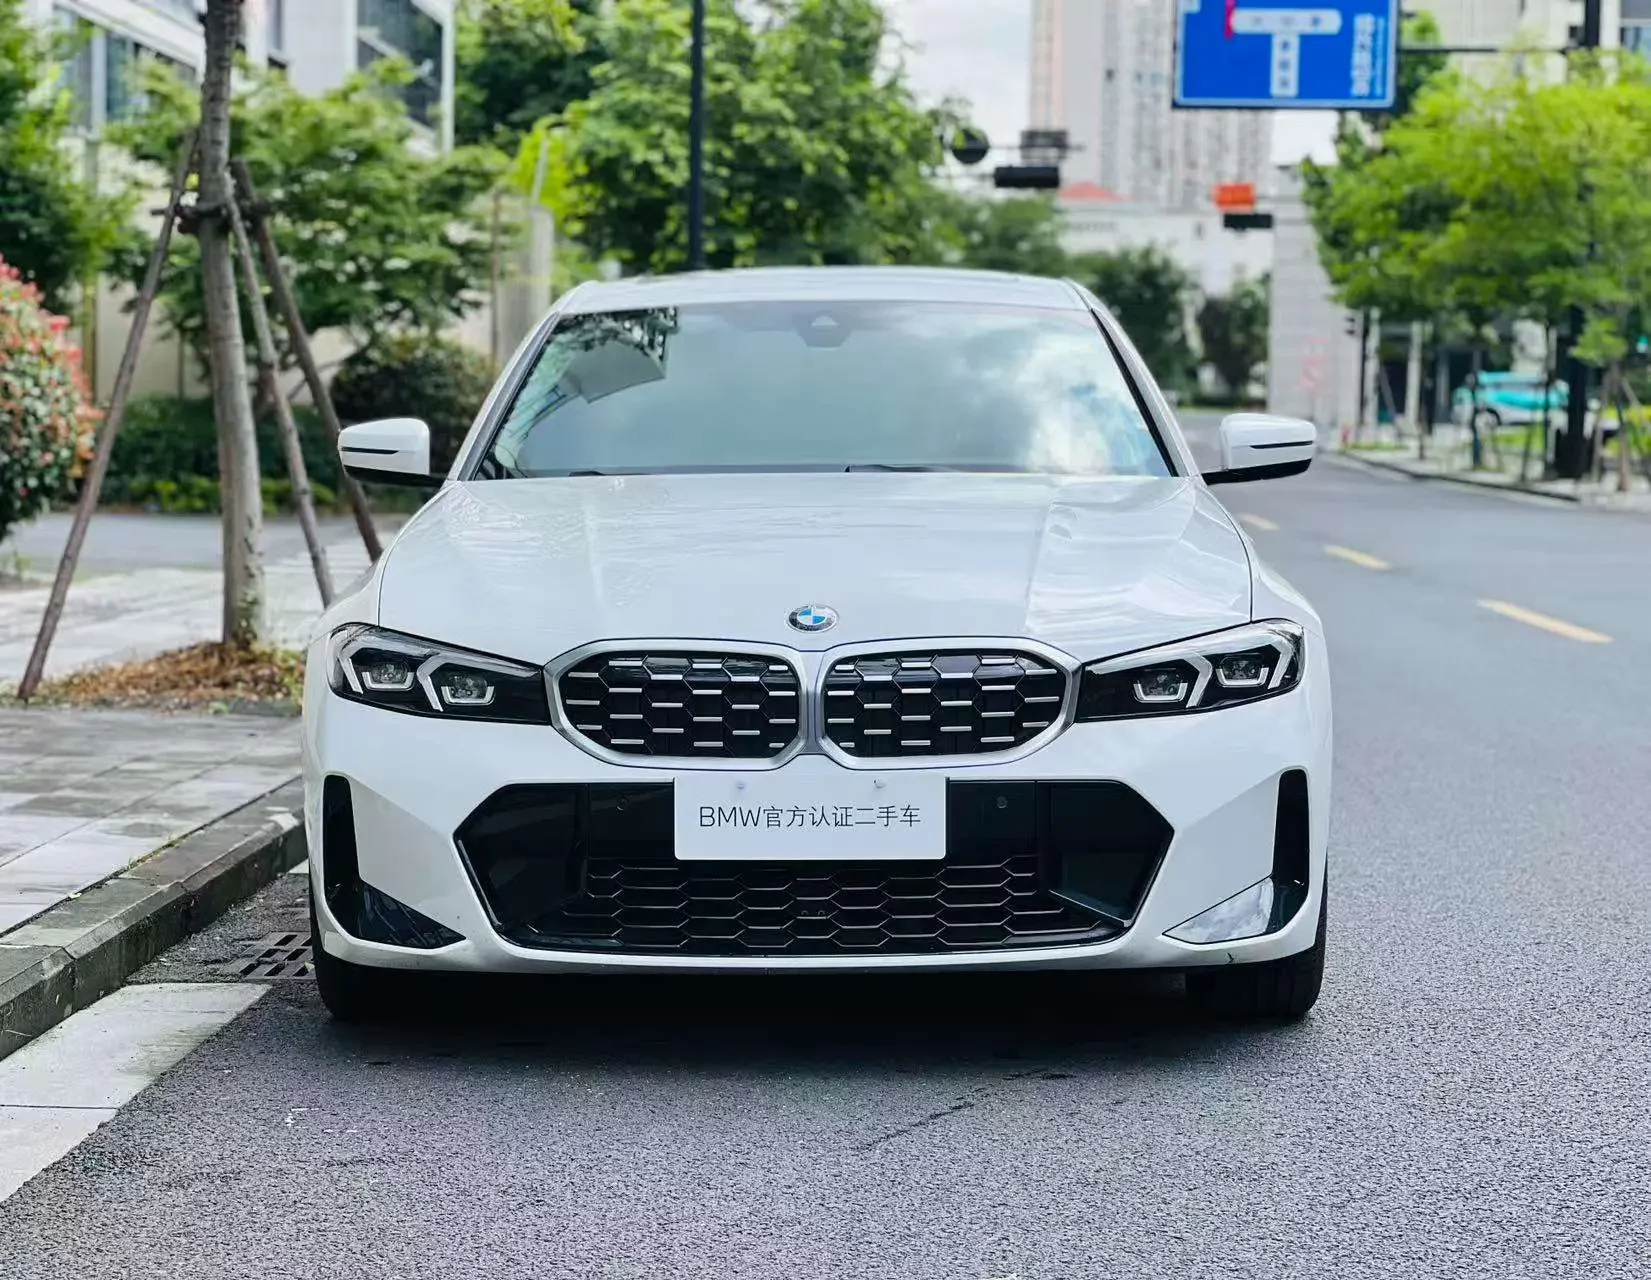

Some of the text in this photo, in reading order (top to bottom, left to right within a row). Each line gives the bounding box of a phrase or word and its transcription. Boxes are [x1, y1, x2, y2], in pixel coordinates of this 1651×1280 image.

[699, 804, 921, 828] BMW官方认证二手车
